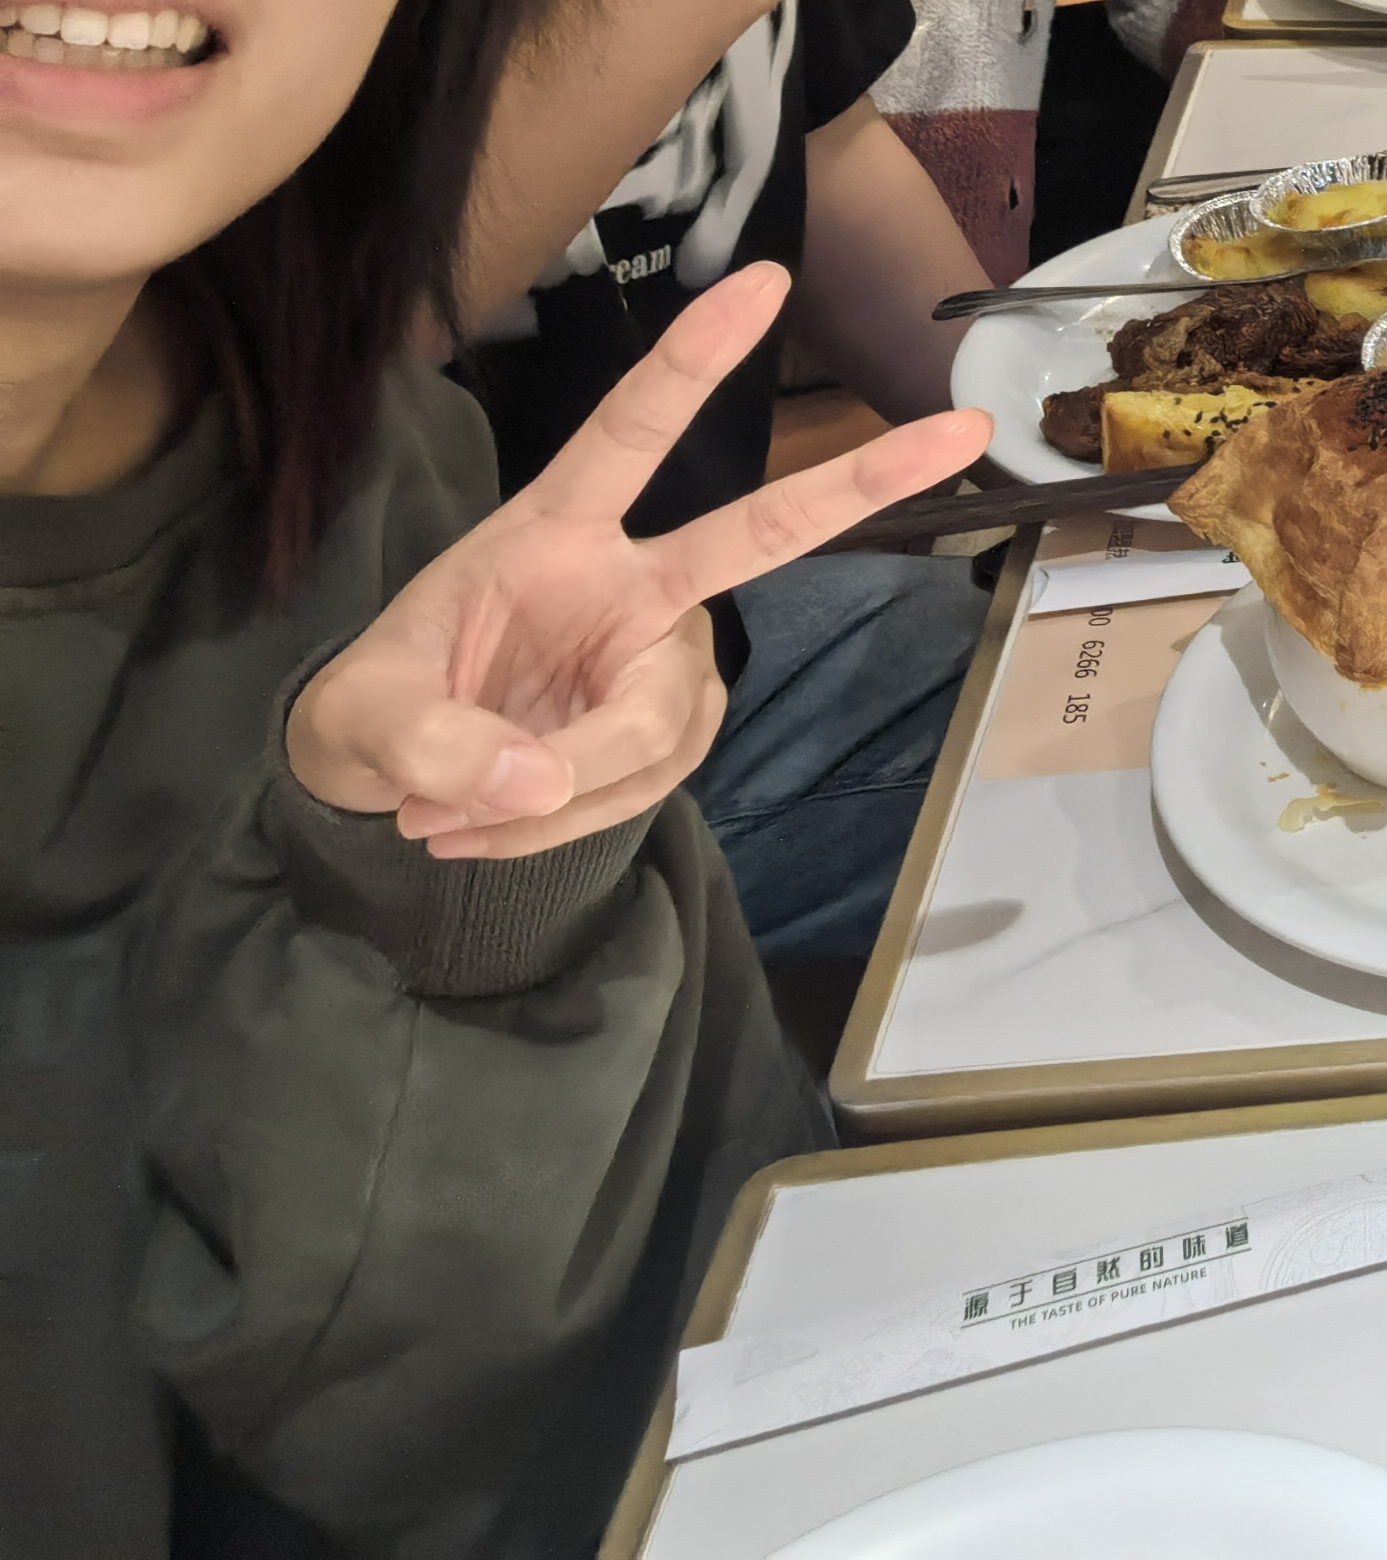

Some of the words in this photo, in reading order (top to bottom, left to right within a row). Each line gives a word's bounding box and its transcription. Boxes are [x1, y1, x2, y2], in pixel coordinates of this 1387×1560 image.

[1074, 640, 1105, 679] 6266
[1062, 693, 1091, 724] 185
[963, 1221, 1250, 1322] 源于自然的味道
[1010, 1312, 1036, 1330] THE
[1041, 1300, 1083, 1321] TASTE
[1088, 1295, 1106, 1308] OF
[1111, 1283, 1148, 1302] PURE
[1152, 1266, 1207, 1292] NATURE
